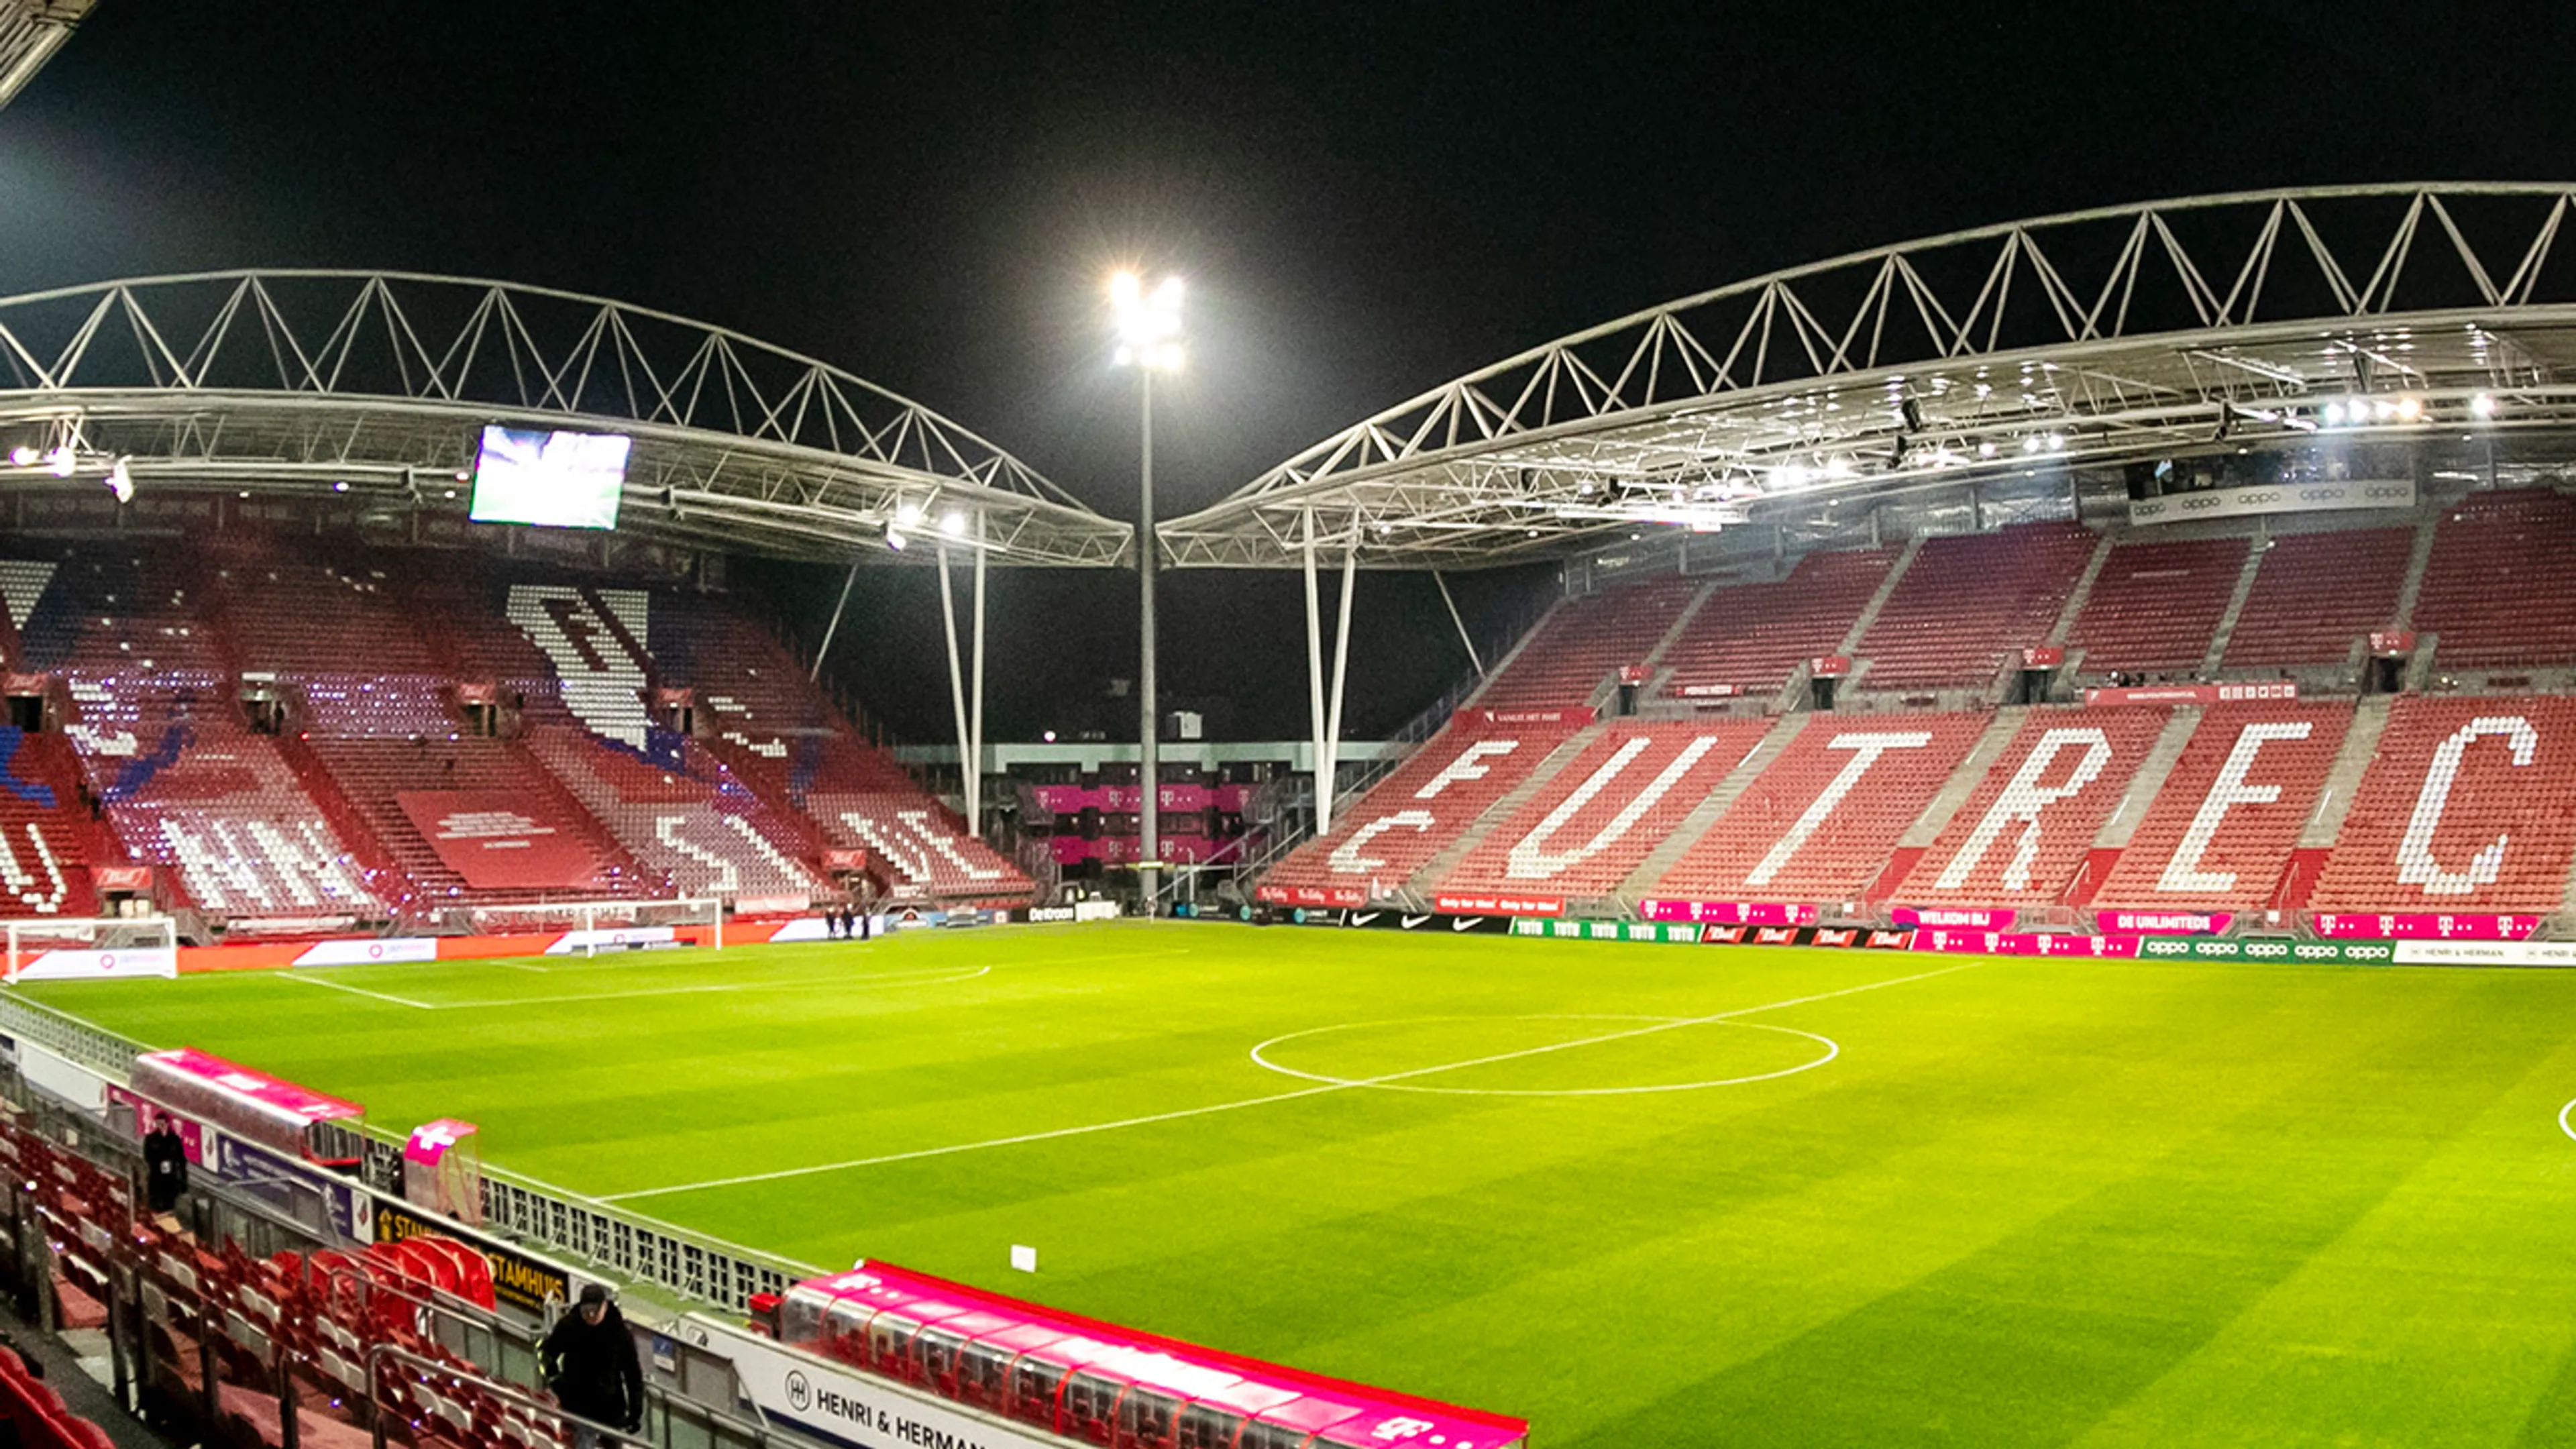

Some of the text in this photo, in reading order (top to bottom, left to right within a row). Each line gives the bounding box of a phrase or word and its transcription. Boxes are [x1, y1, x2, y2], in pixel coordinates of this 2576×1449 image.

[1919, 911, 1990, 926] WELKOM BIJ
[2117, 915, 2210, 930] DE UNLIMITEDS
[2147, 942, 2390, 960] oppo oppo oppo oppo oppo
[488, 1253, 565, 1301] STAMHUIS
[816, 1388, 873, 1428] HENRI
[877, 1410, 891, 1434] &
